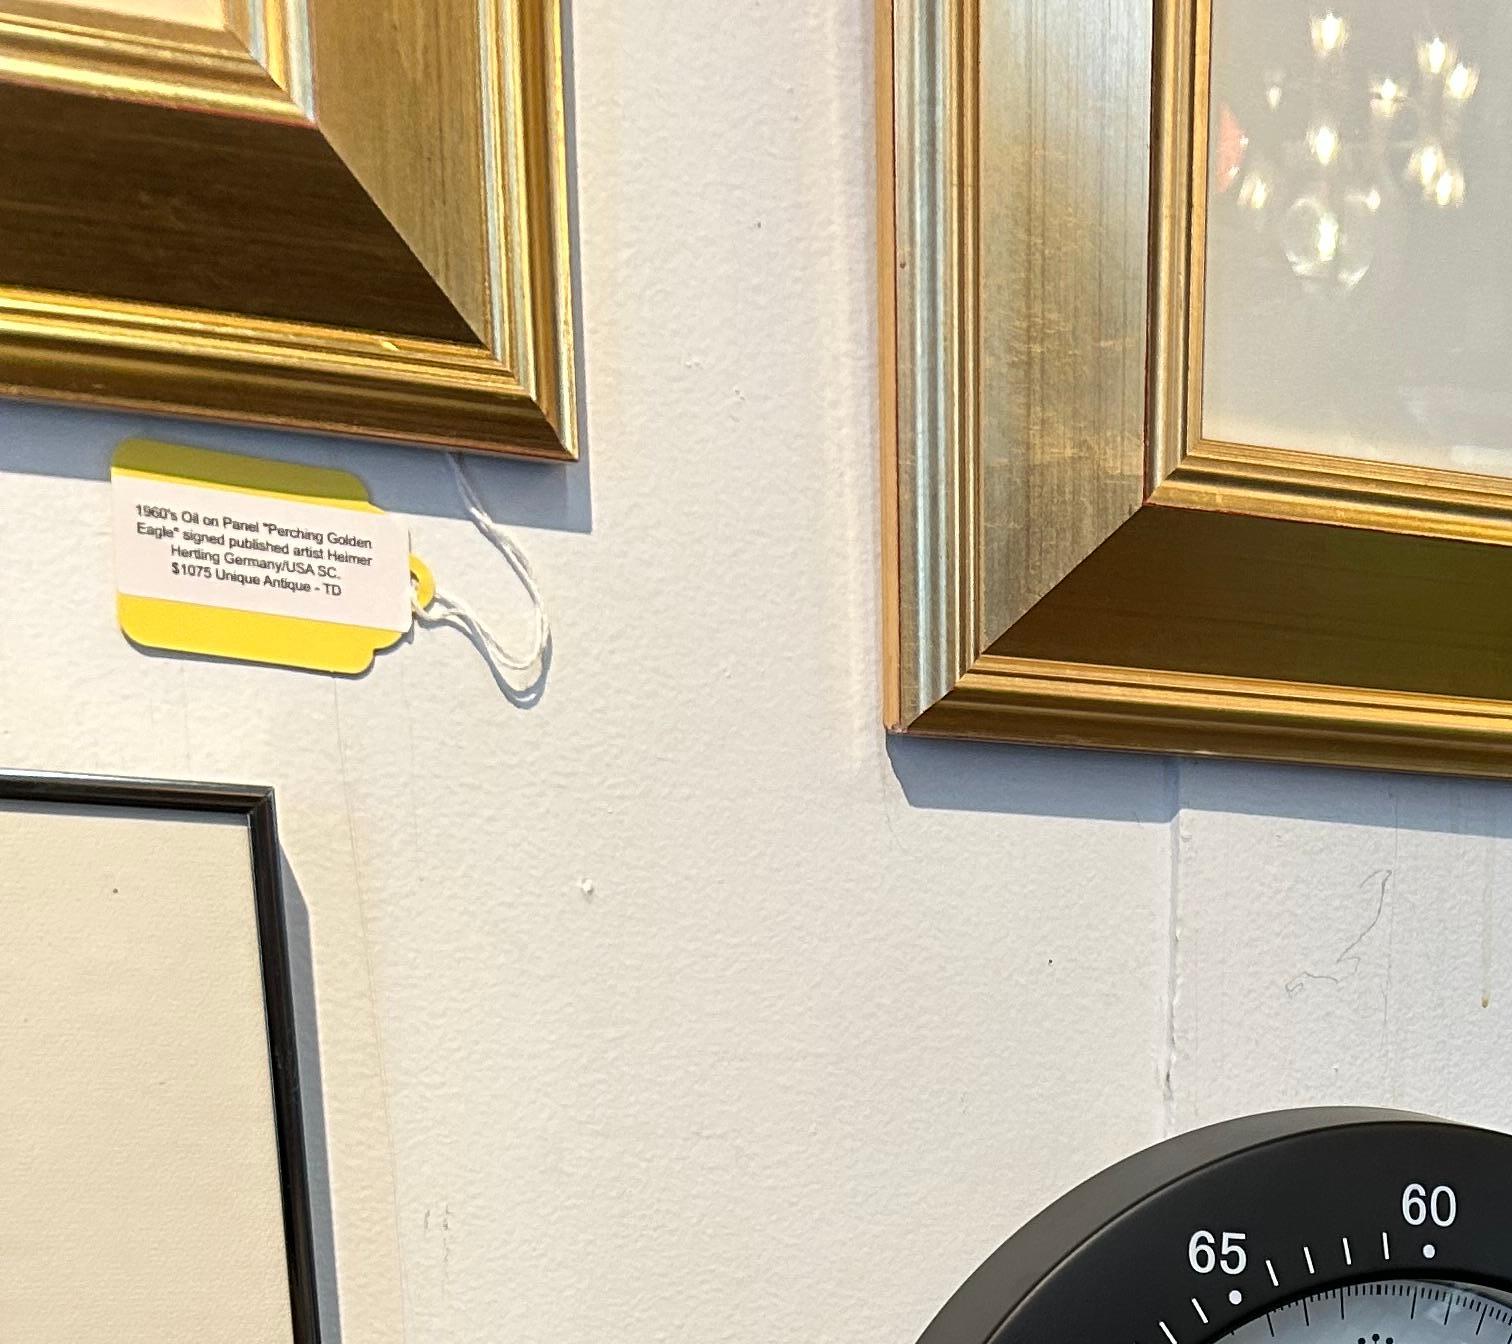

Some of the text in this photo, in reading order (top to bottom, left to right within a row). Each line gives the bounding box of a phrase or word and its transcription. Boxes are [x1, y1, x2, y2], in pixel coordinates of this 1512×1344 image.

[136, 504, 178, 521] 1960's
[182, 510, 199, 525] Oil
[203, 516, 219, 527] on
[223, 516, 259, 533] Panel
[327, 531, 372, 549] Golden
[183, 529, 225, 545] signed
[229, 535, 289, 555] published
[294, 546, 323, 559] artist
[171, 561, 212, 579] $1075
[216, 567, 260, 586] Unique
[263, 575, 311, 593] Antique
[224, 552, 315, 576] Germany/USA
[1402, 1183, 1457, 1227] 60
[1188, 1230, 1247, 1275] 65
